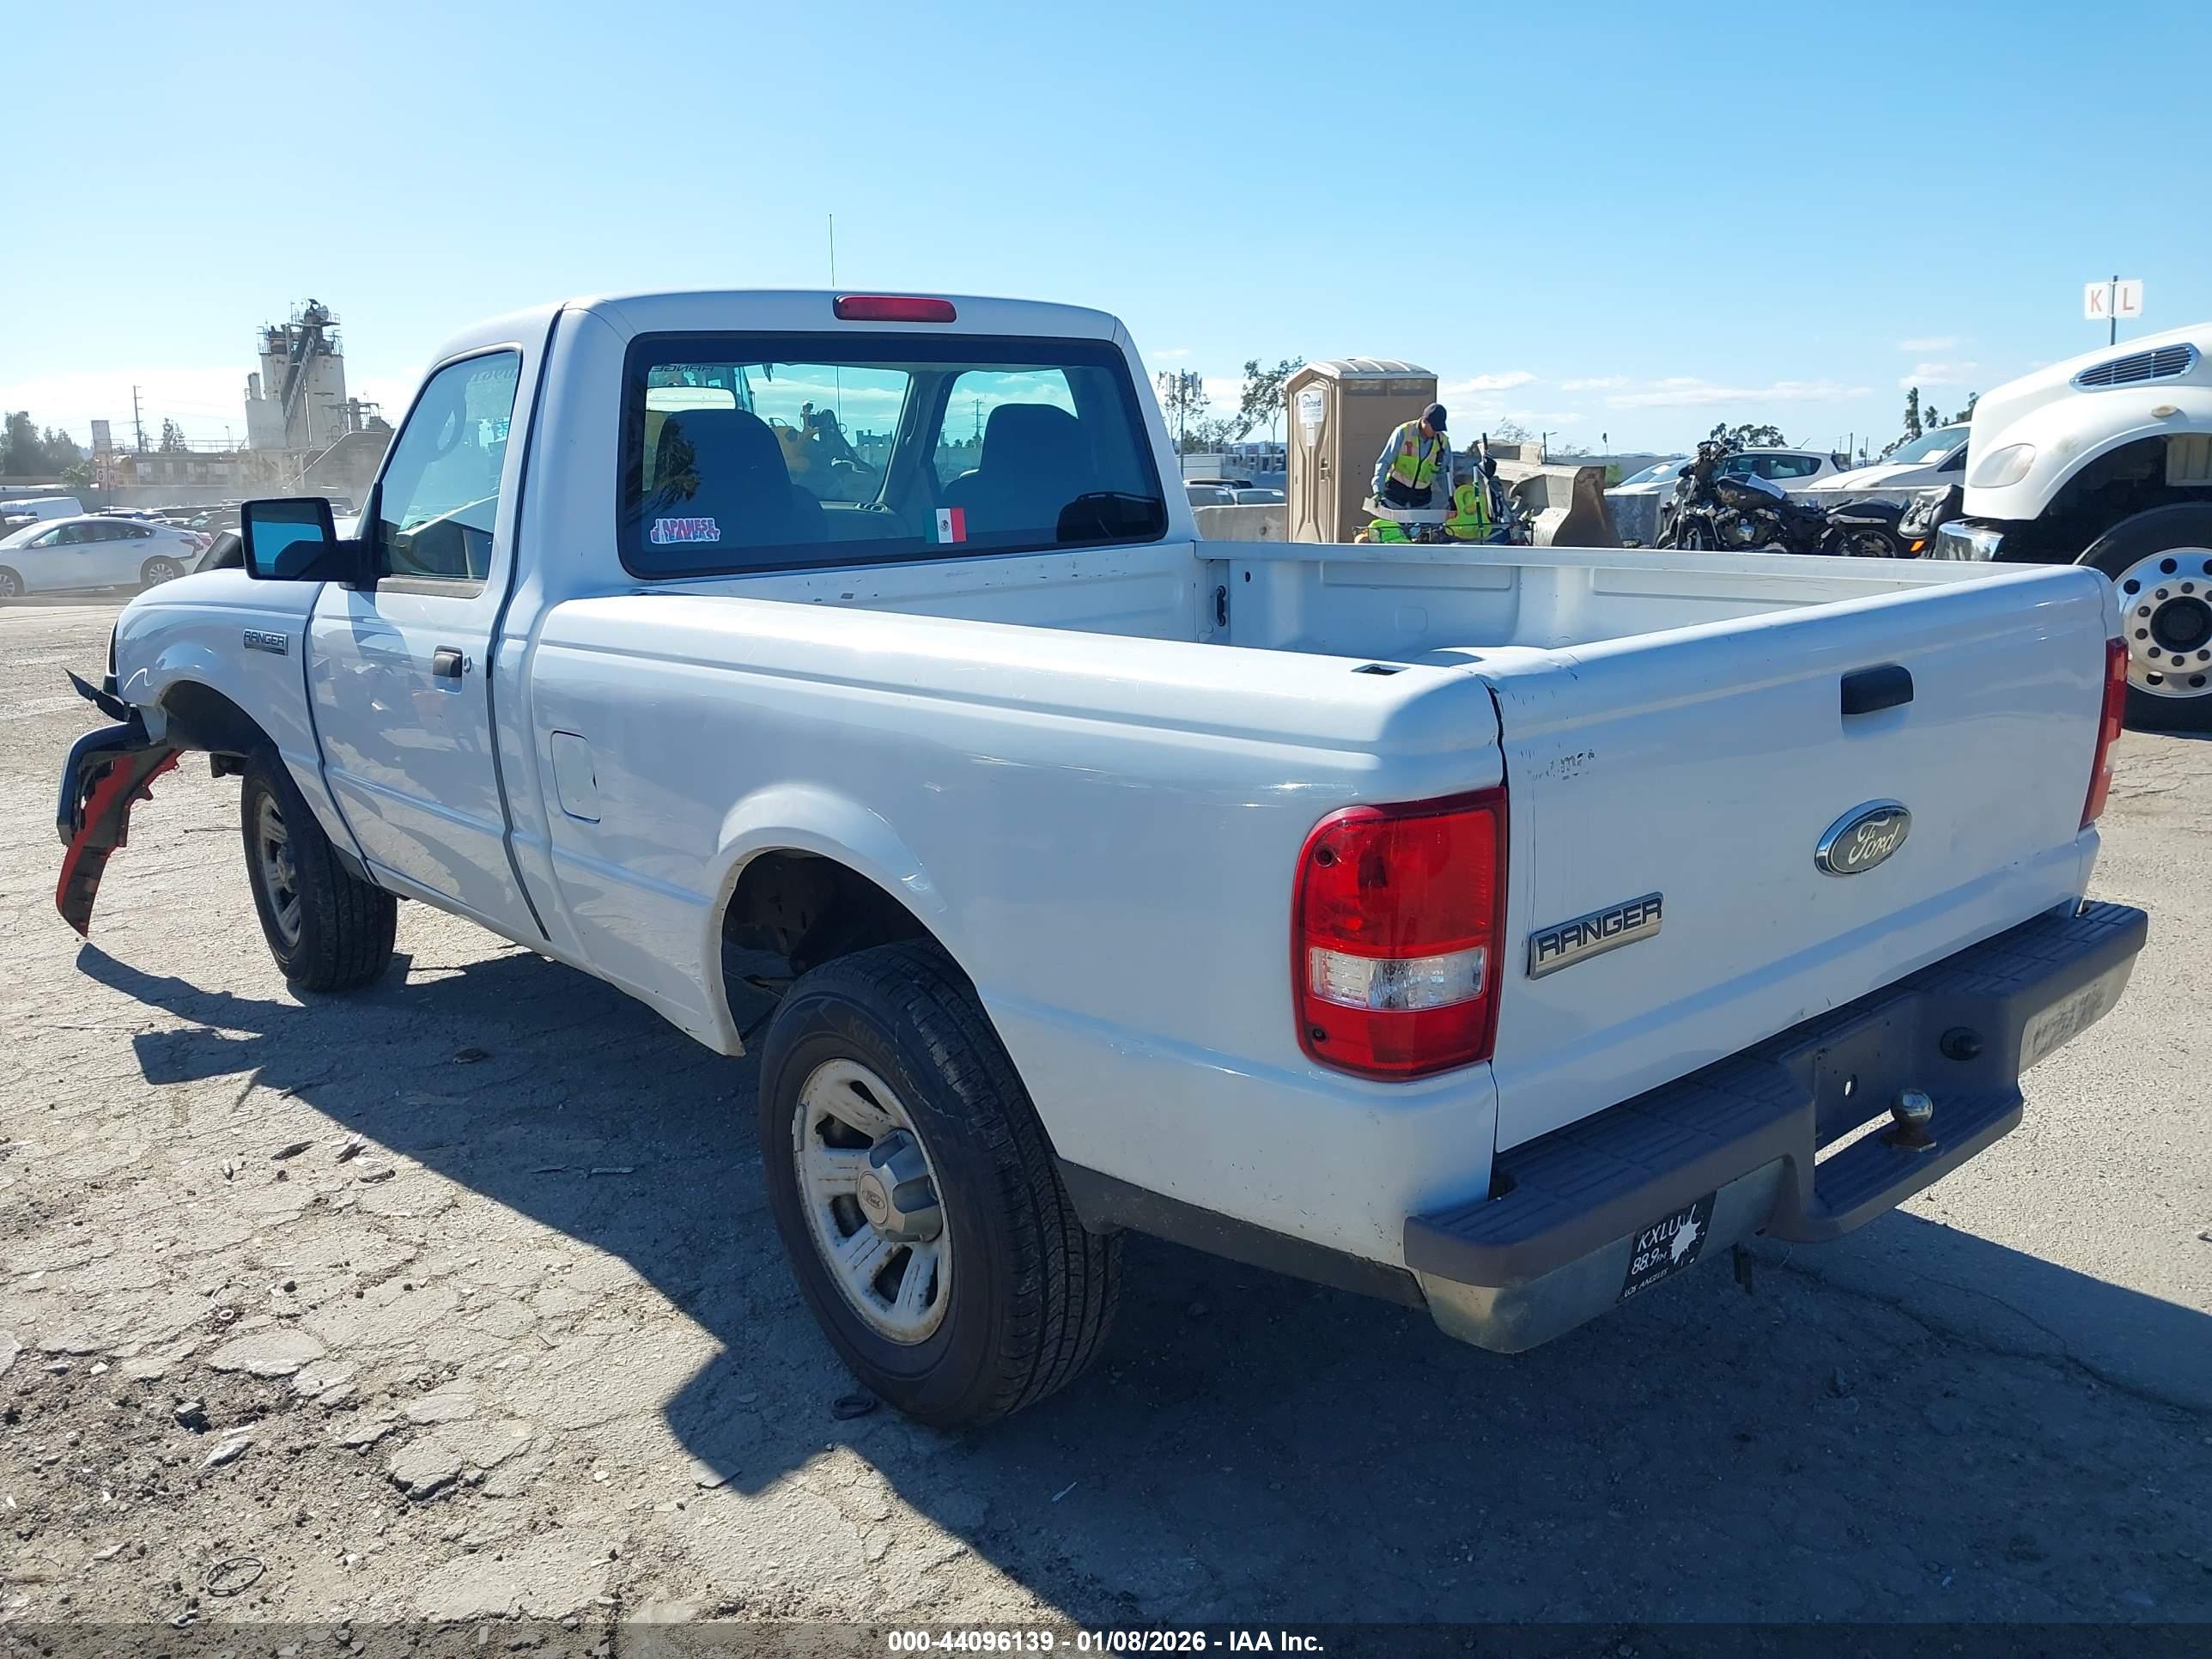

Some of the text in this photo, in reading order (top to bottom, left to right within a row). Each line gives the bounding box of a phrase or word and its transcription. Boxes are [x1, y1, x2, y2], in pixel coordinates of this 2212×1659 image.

[2090, 287, 2135, 313] K L
[98, 470, 104, 481] G
[244, 629, 286, 647] RANGER
[1848, 817, 1901, 865] Ford
[1537, 897, 1662, 962] RANGER
[1637, 1215, 1681, 1253] KXLU
[1624, 1284, 1638, 1298] LOS
